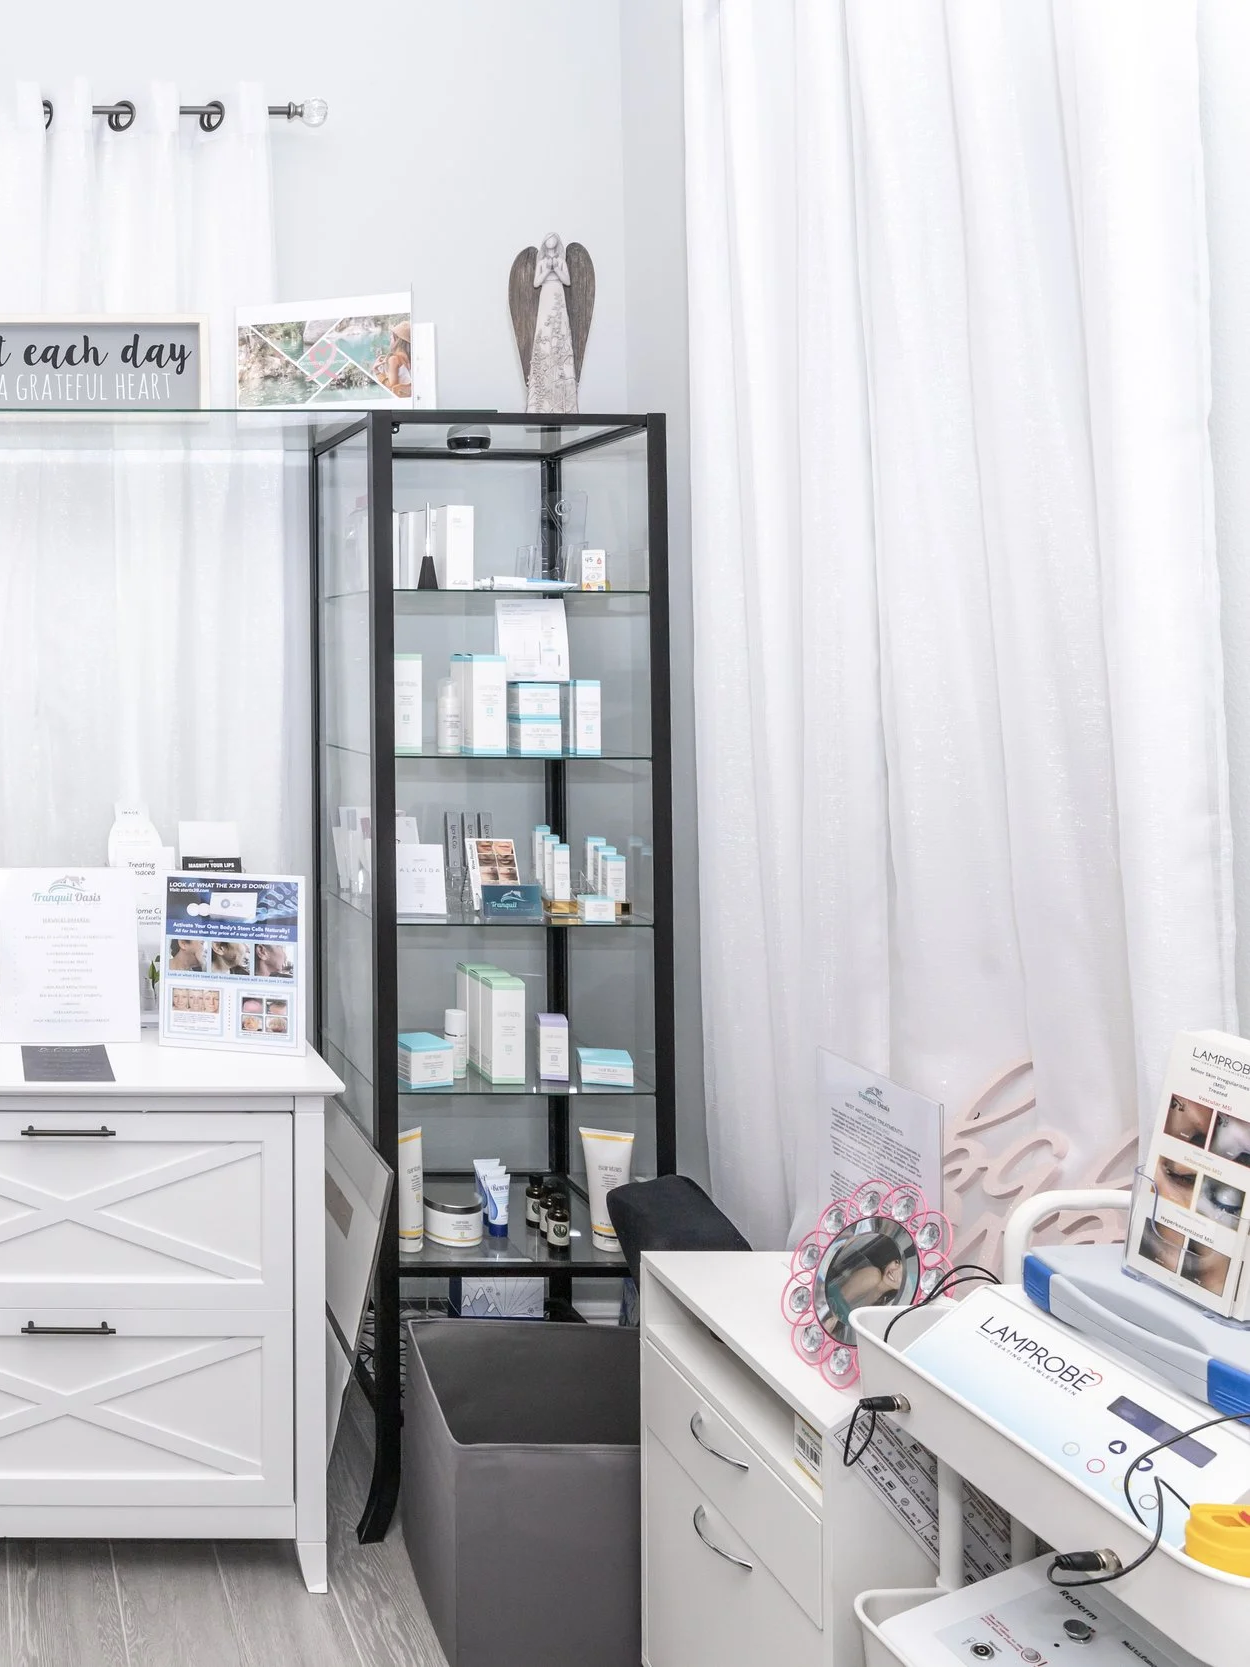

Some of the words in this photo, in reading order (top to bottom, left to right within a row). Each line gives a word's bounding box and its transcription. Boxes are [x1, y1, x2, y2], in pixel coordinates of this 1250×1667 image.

[23, 335, 108, 370] each
[120, 333, 192, 375] day
[16, 373, 106, 401] GRATEFUL
[115, 372, 171, 400] HEART
[128, 861, 156, 869] Treating
[31, 892, 73, 905] Tranquil
[74, 892, 101, 902] Oasis
[136, 907, 153, 915] ome
[490, 901, 517, 910] Tranquil
[1190, 1066, 1205, 1075] Minor
[1205, 1072, 1217, 1080] Skin
[1208, 1087, 1228, 1098] Treated
[1198, 1095, 1221, 1107] Vascular
[979, 1316, 1094, 1391] LAMPROBE
[989, 1338, 1022, 1362] CREATING
[1023, 1361, 1064, 1389] FLAWLESS
[1059, 1381, 1077, 1397] SKIN
[1058, 1589, 1099, 1621] ReDerm
